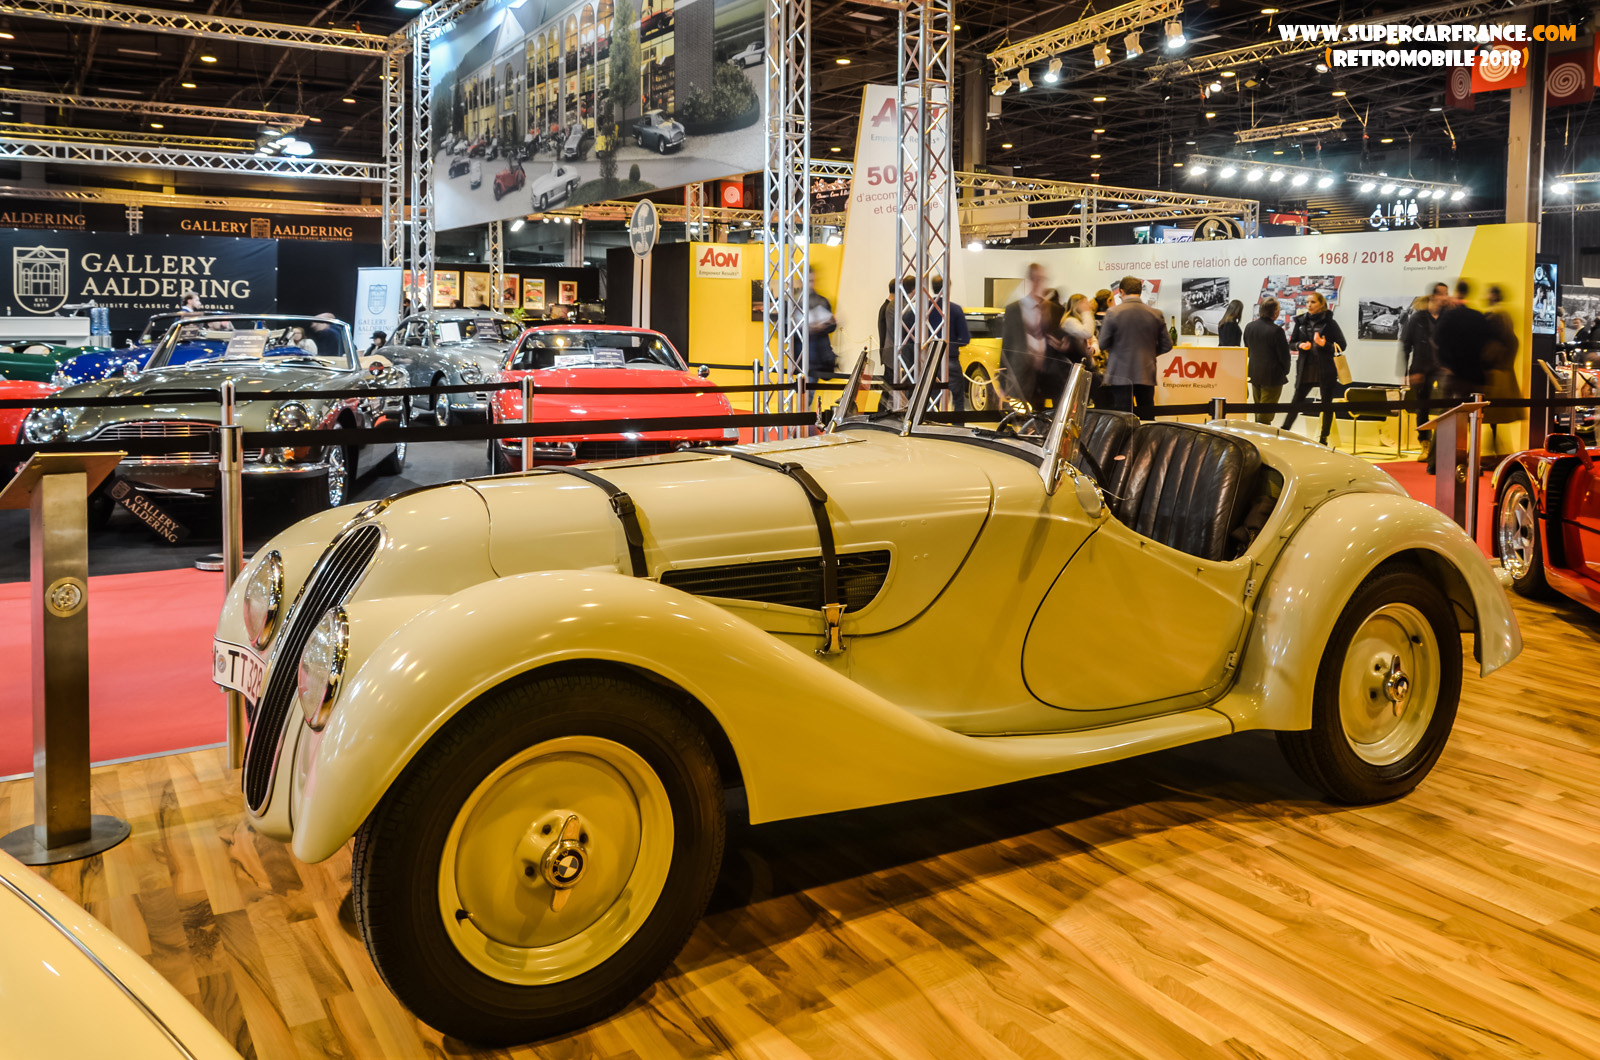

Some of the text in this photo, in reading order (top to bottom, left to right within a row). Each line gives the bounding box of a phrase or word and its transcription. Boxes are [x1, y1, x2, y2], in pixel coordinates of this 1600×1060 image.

[867, 165, 898, 186] 50
[0, 212, 86, 226] ALDERING
[873, 206, 885, 215] et
[180, 219, 353, 237] GALLERY AALDERING
[631, 223, 654, 235] SHELBY
[81, 253, 216, 275] GALLERY
[1098, 251, 1394, 271] L'assurance est une relation de confiance 1968 / 2018
[80, 277, 251, 298] AALDERING
[121, 498, 178, 543] AALDERING
[134, 495, 179, 531] GALLERY
